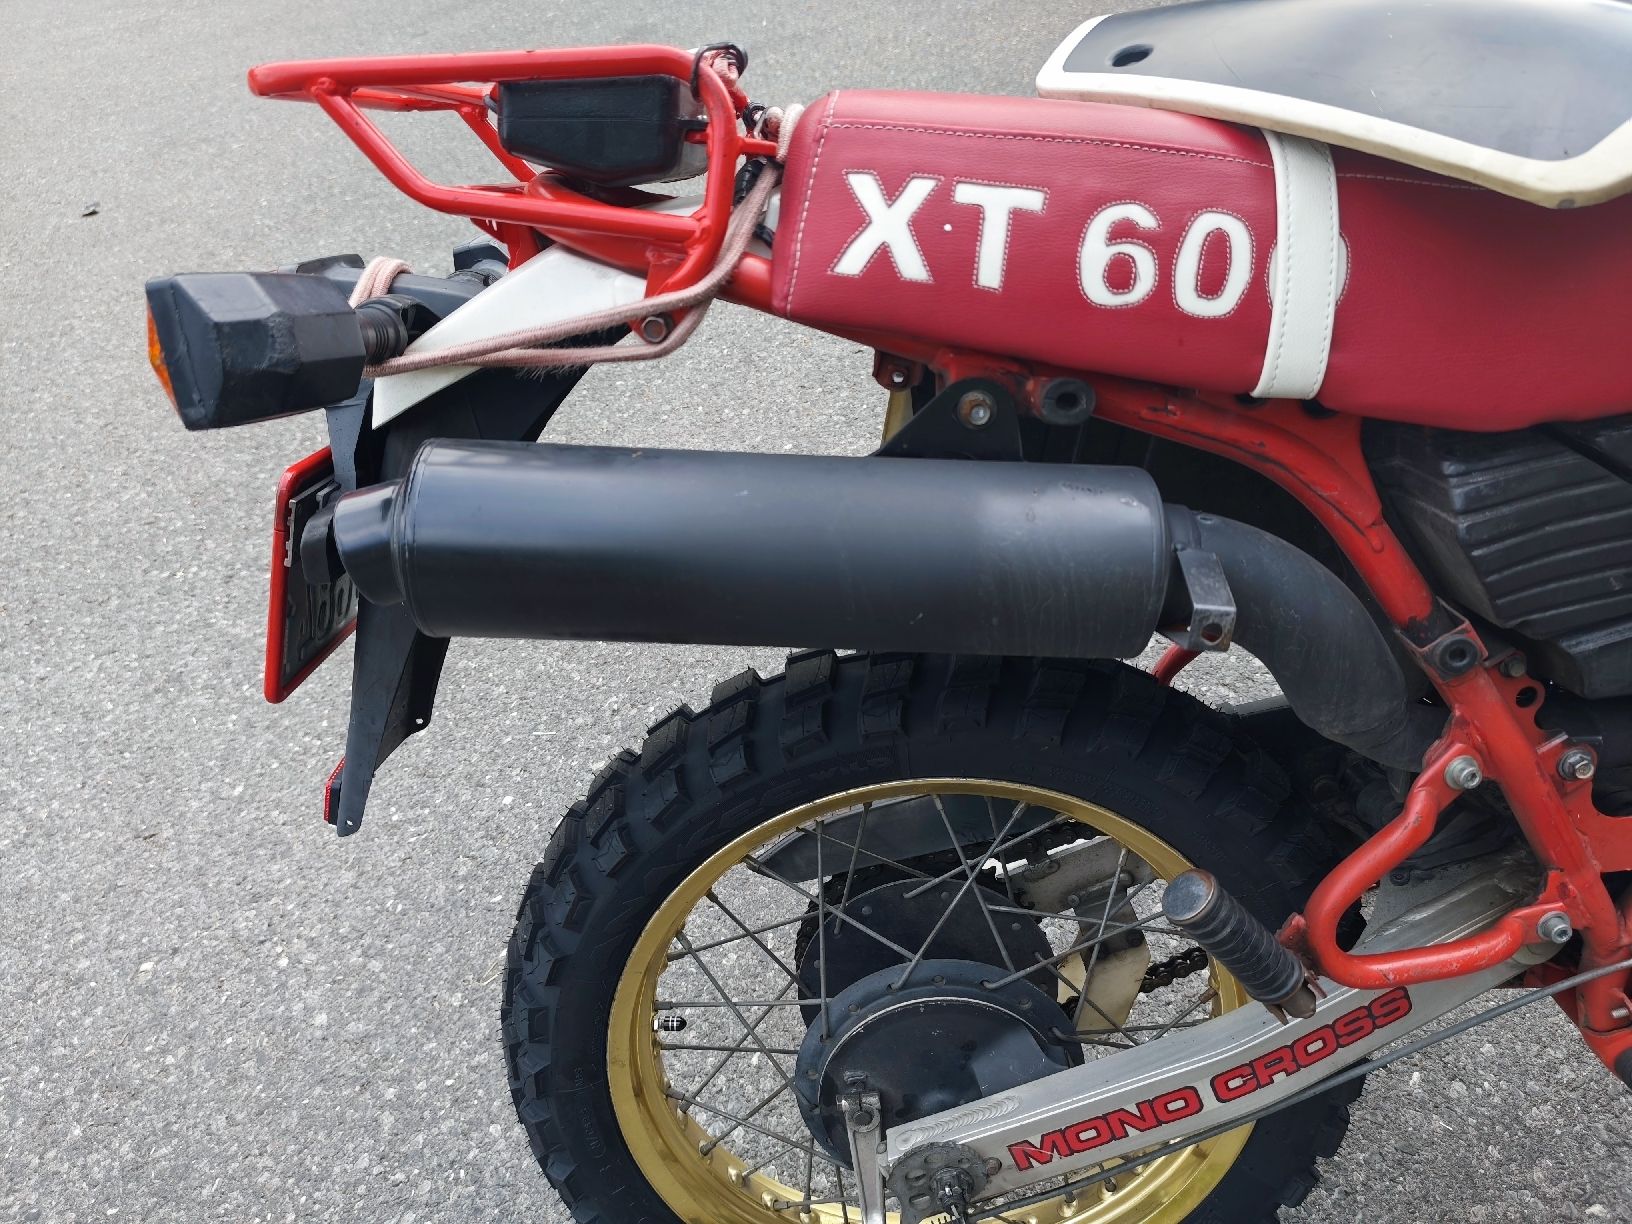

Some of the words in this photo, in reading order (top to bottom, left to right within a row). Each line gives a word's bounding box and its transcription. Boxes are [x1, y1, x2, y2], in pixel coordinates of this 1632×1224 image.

[828, 169, 1050, 292] XT
[1077, 199, 1351, 319] 60
[1008, 1086, 1204, 1172] MONO
[1210, 986, 1413, 1103] CROSS
